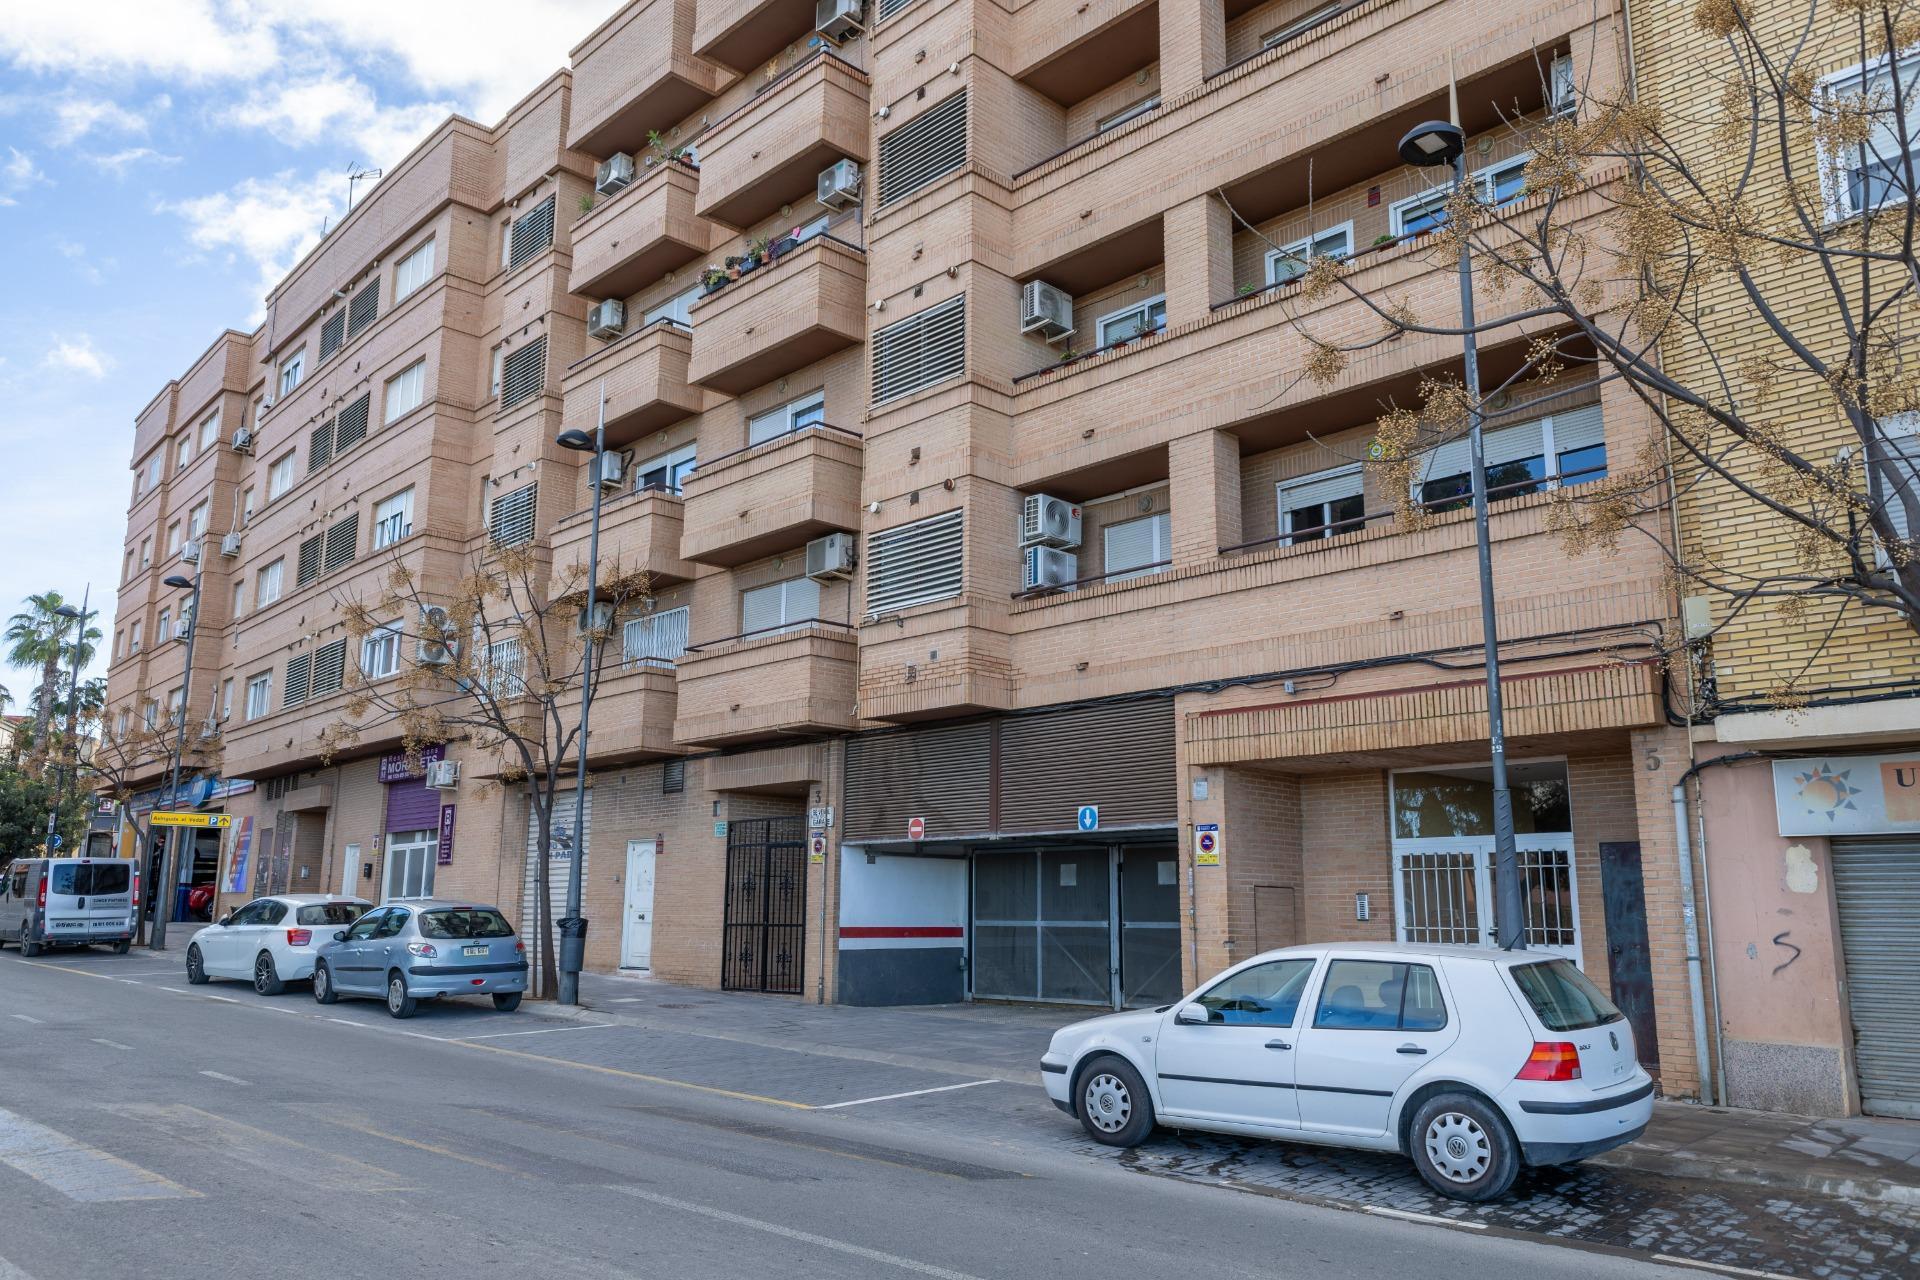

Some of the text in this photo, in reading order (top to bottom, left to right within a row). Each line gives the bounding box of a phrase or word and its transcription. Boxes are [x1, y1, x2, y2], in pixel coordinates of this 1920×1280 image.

[387, 755, 438, 774] MORETS
[1645, 747, 1660, 771] 5
[1893, 767, 1920, 788] U
[815, 790, 821, 804] 3
